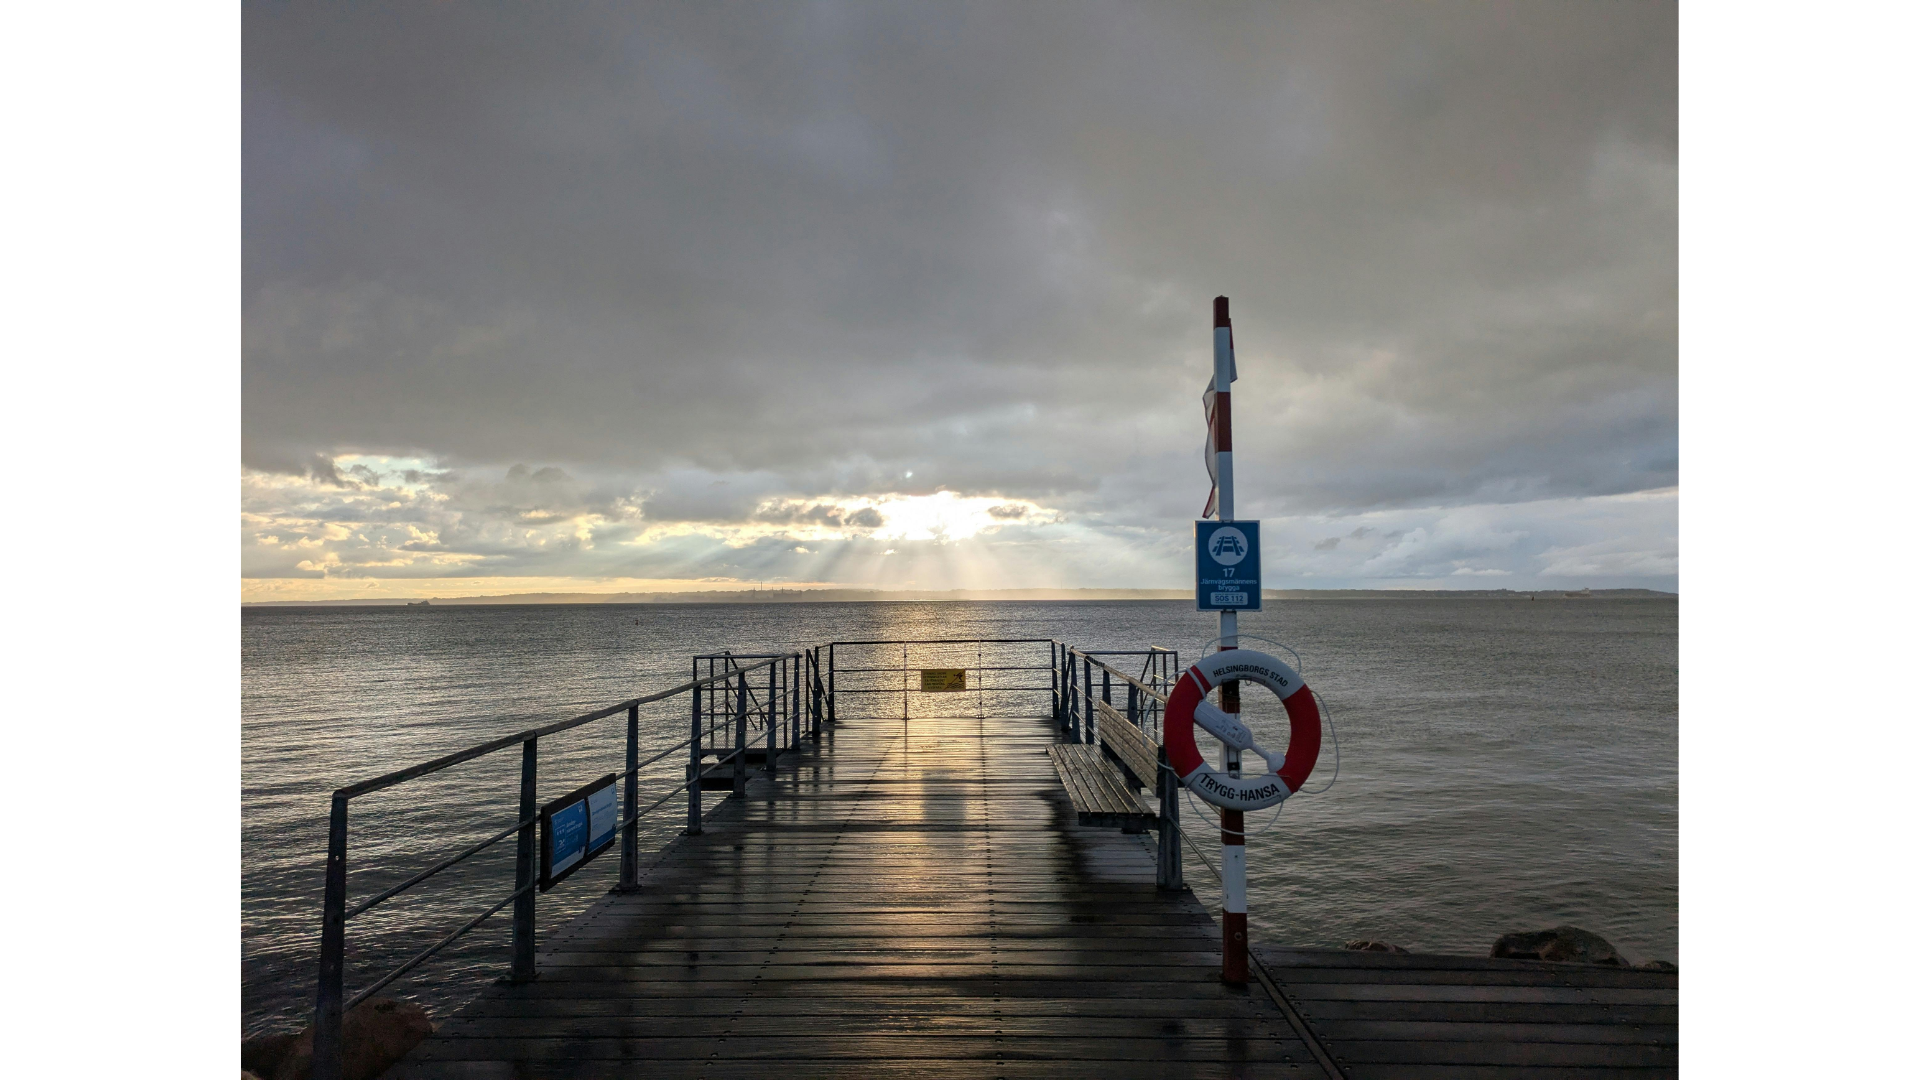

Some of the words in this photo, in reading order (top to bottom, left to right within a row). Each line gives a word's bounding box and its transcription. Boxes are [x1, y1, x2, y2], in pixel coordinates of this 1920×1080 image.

[1223, 568, 1235, 578] 17
[1212, 664, 1270, 676] HELSINGBORGS
[1270, 671, 1288, 687] STAD
[1200, 774, 1280, 802] TRYGG-HANSA
